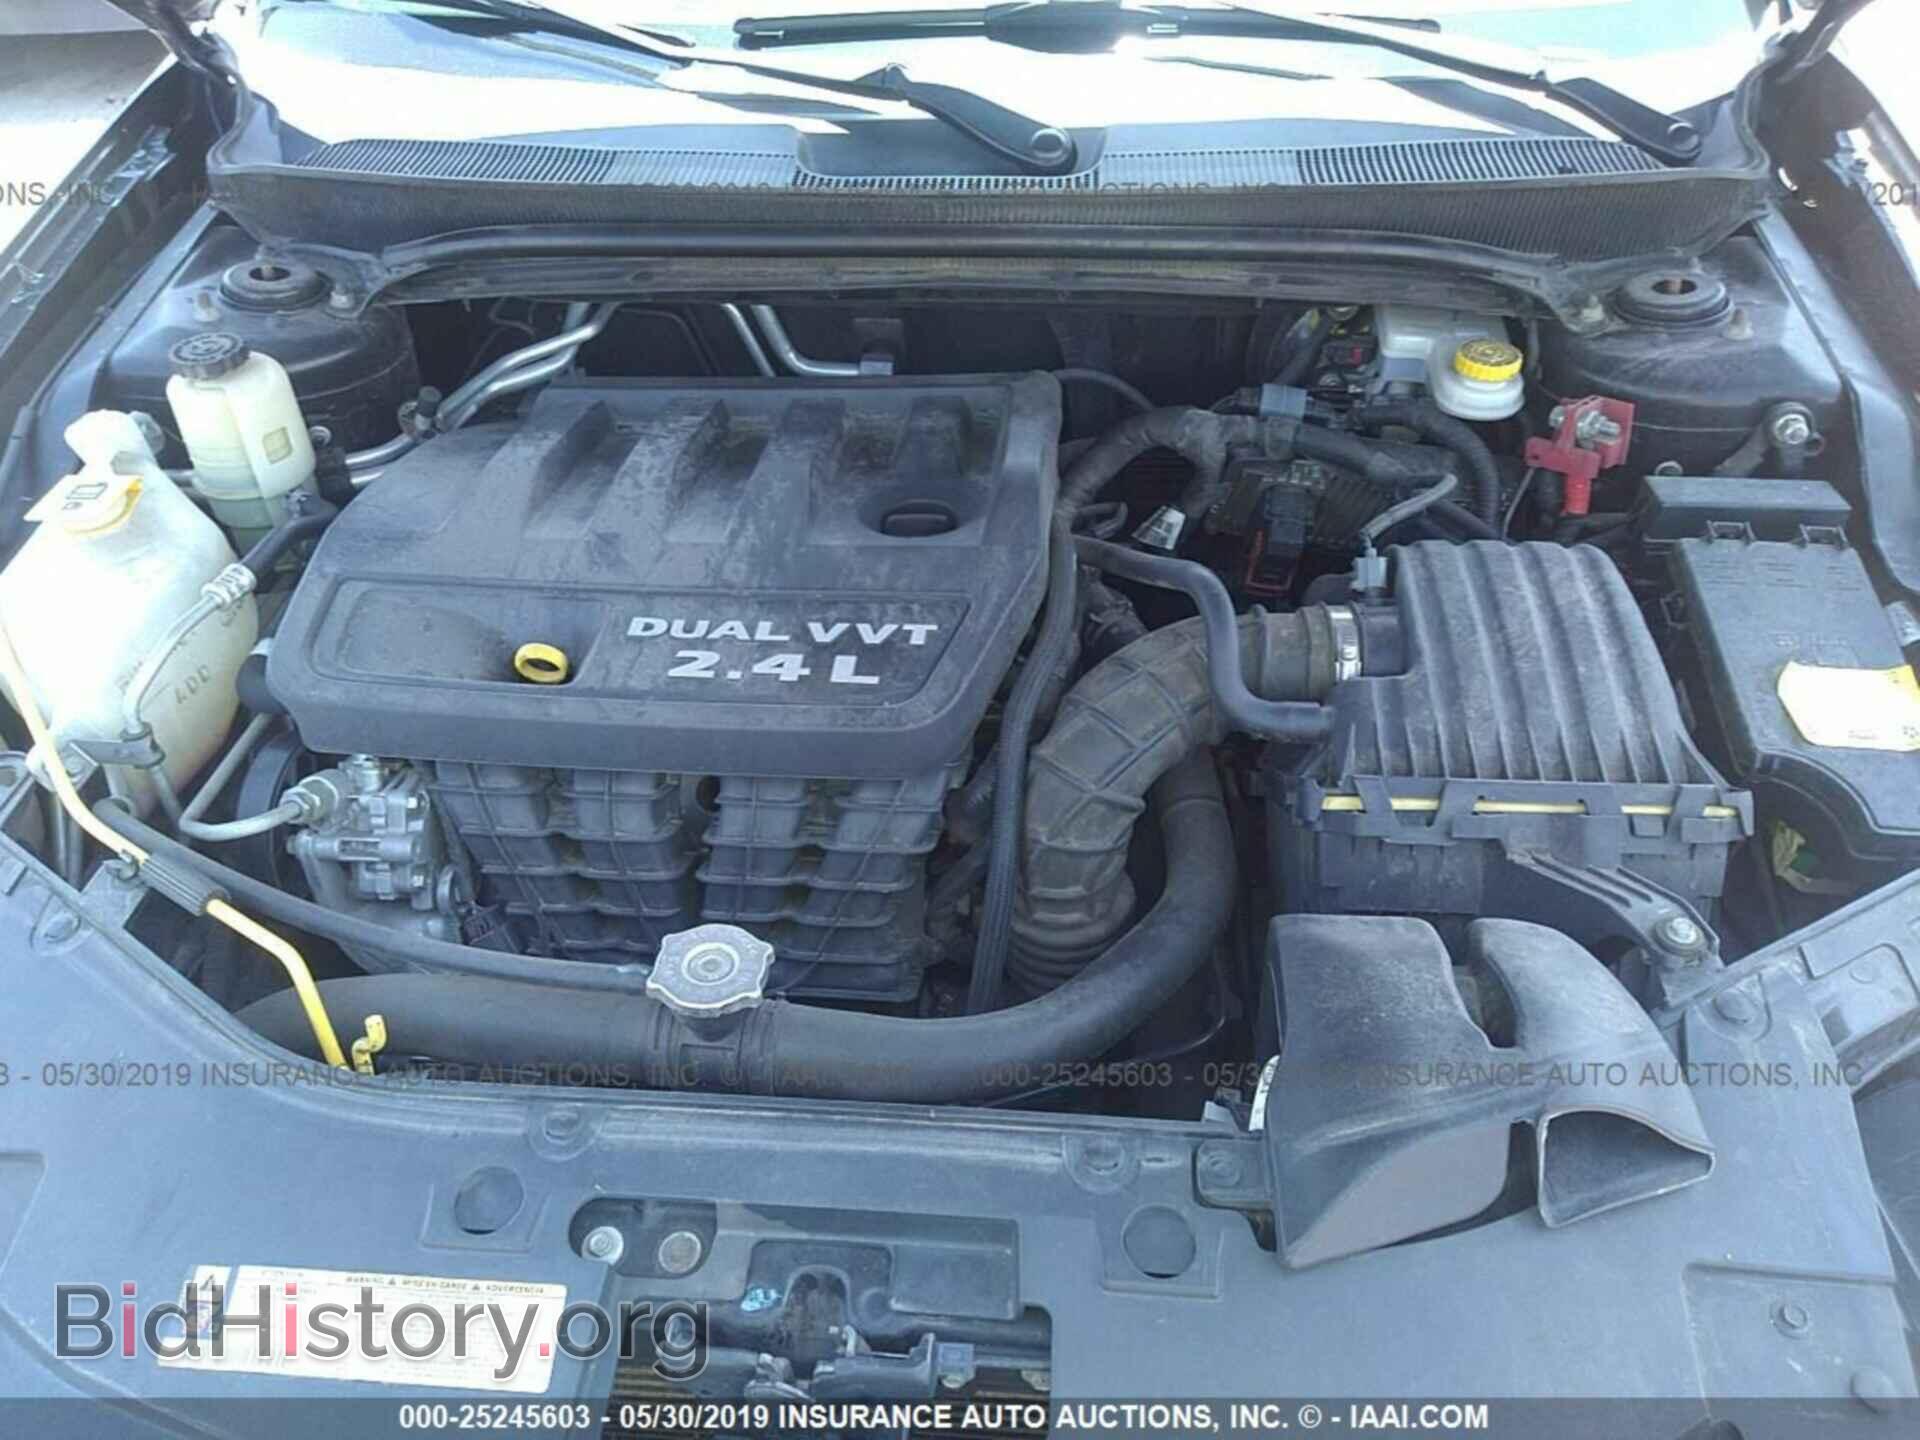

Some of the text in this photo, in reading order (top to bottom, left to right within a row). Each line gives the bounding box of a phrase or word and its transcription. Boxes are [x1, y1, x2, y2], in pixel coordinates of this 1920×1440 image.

[627, 616, 938, 645] DUAL VVT
[667, 650, 880, 685] 2.4 L
